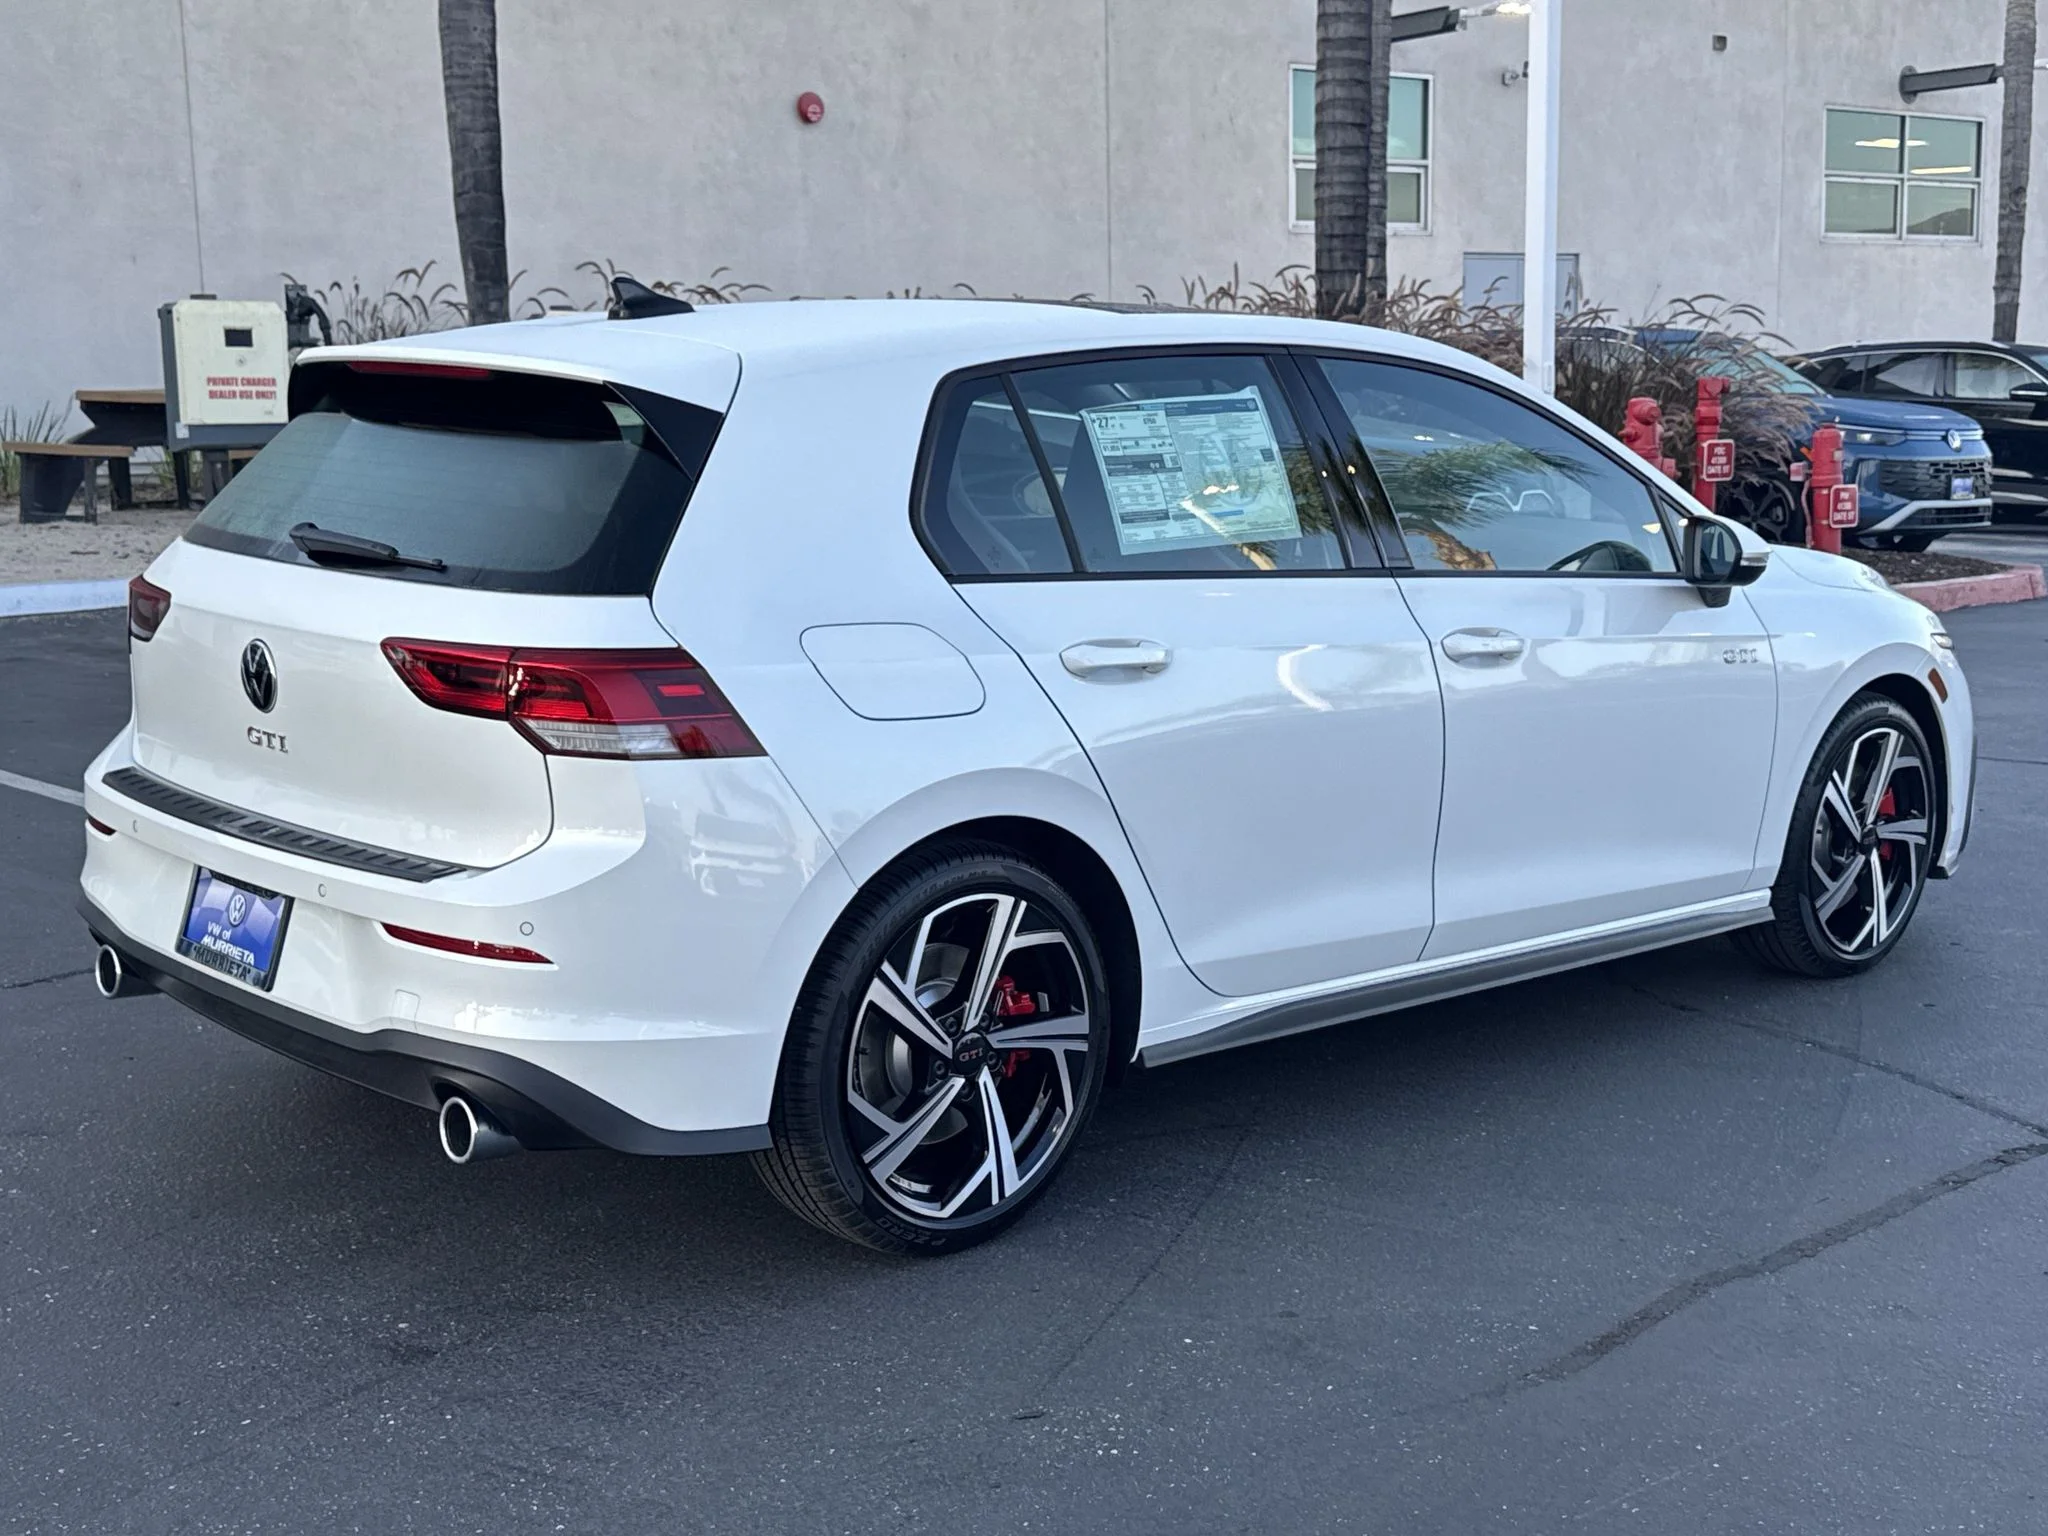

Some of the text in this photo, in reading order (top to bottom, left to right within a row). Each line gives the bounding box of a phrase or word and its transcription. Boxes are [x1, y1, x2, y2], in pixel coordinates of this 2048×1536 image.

[207, 377, 277, 387] PRIVATE CHARGER
[208, 390, 237, 399] DEALER
[239, 390, 253, 399] USE
[1097, 417, 1108, 428] 27
[1707, 465, 1721, 474] DATE
[1833, 511, 1846, 520] DATE
[1723, 648, 1759, 664] GTI
[247, 726, 289, 754] GTI
[208, 921, 232, 941] VW of
[201, 935, 255, 966] MURRIETA
[959, 1047, 983, 1062] GTI
